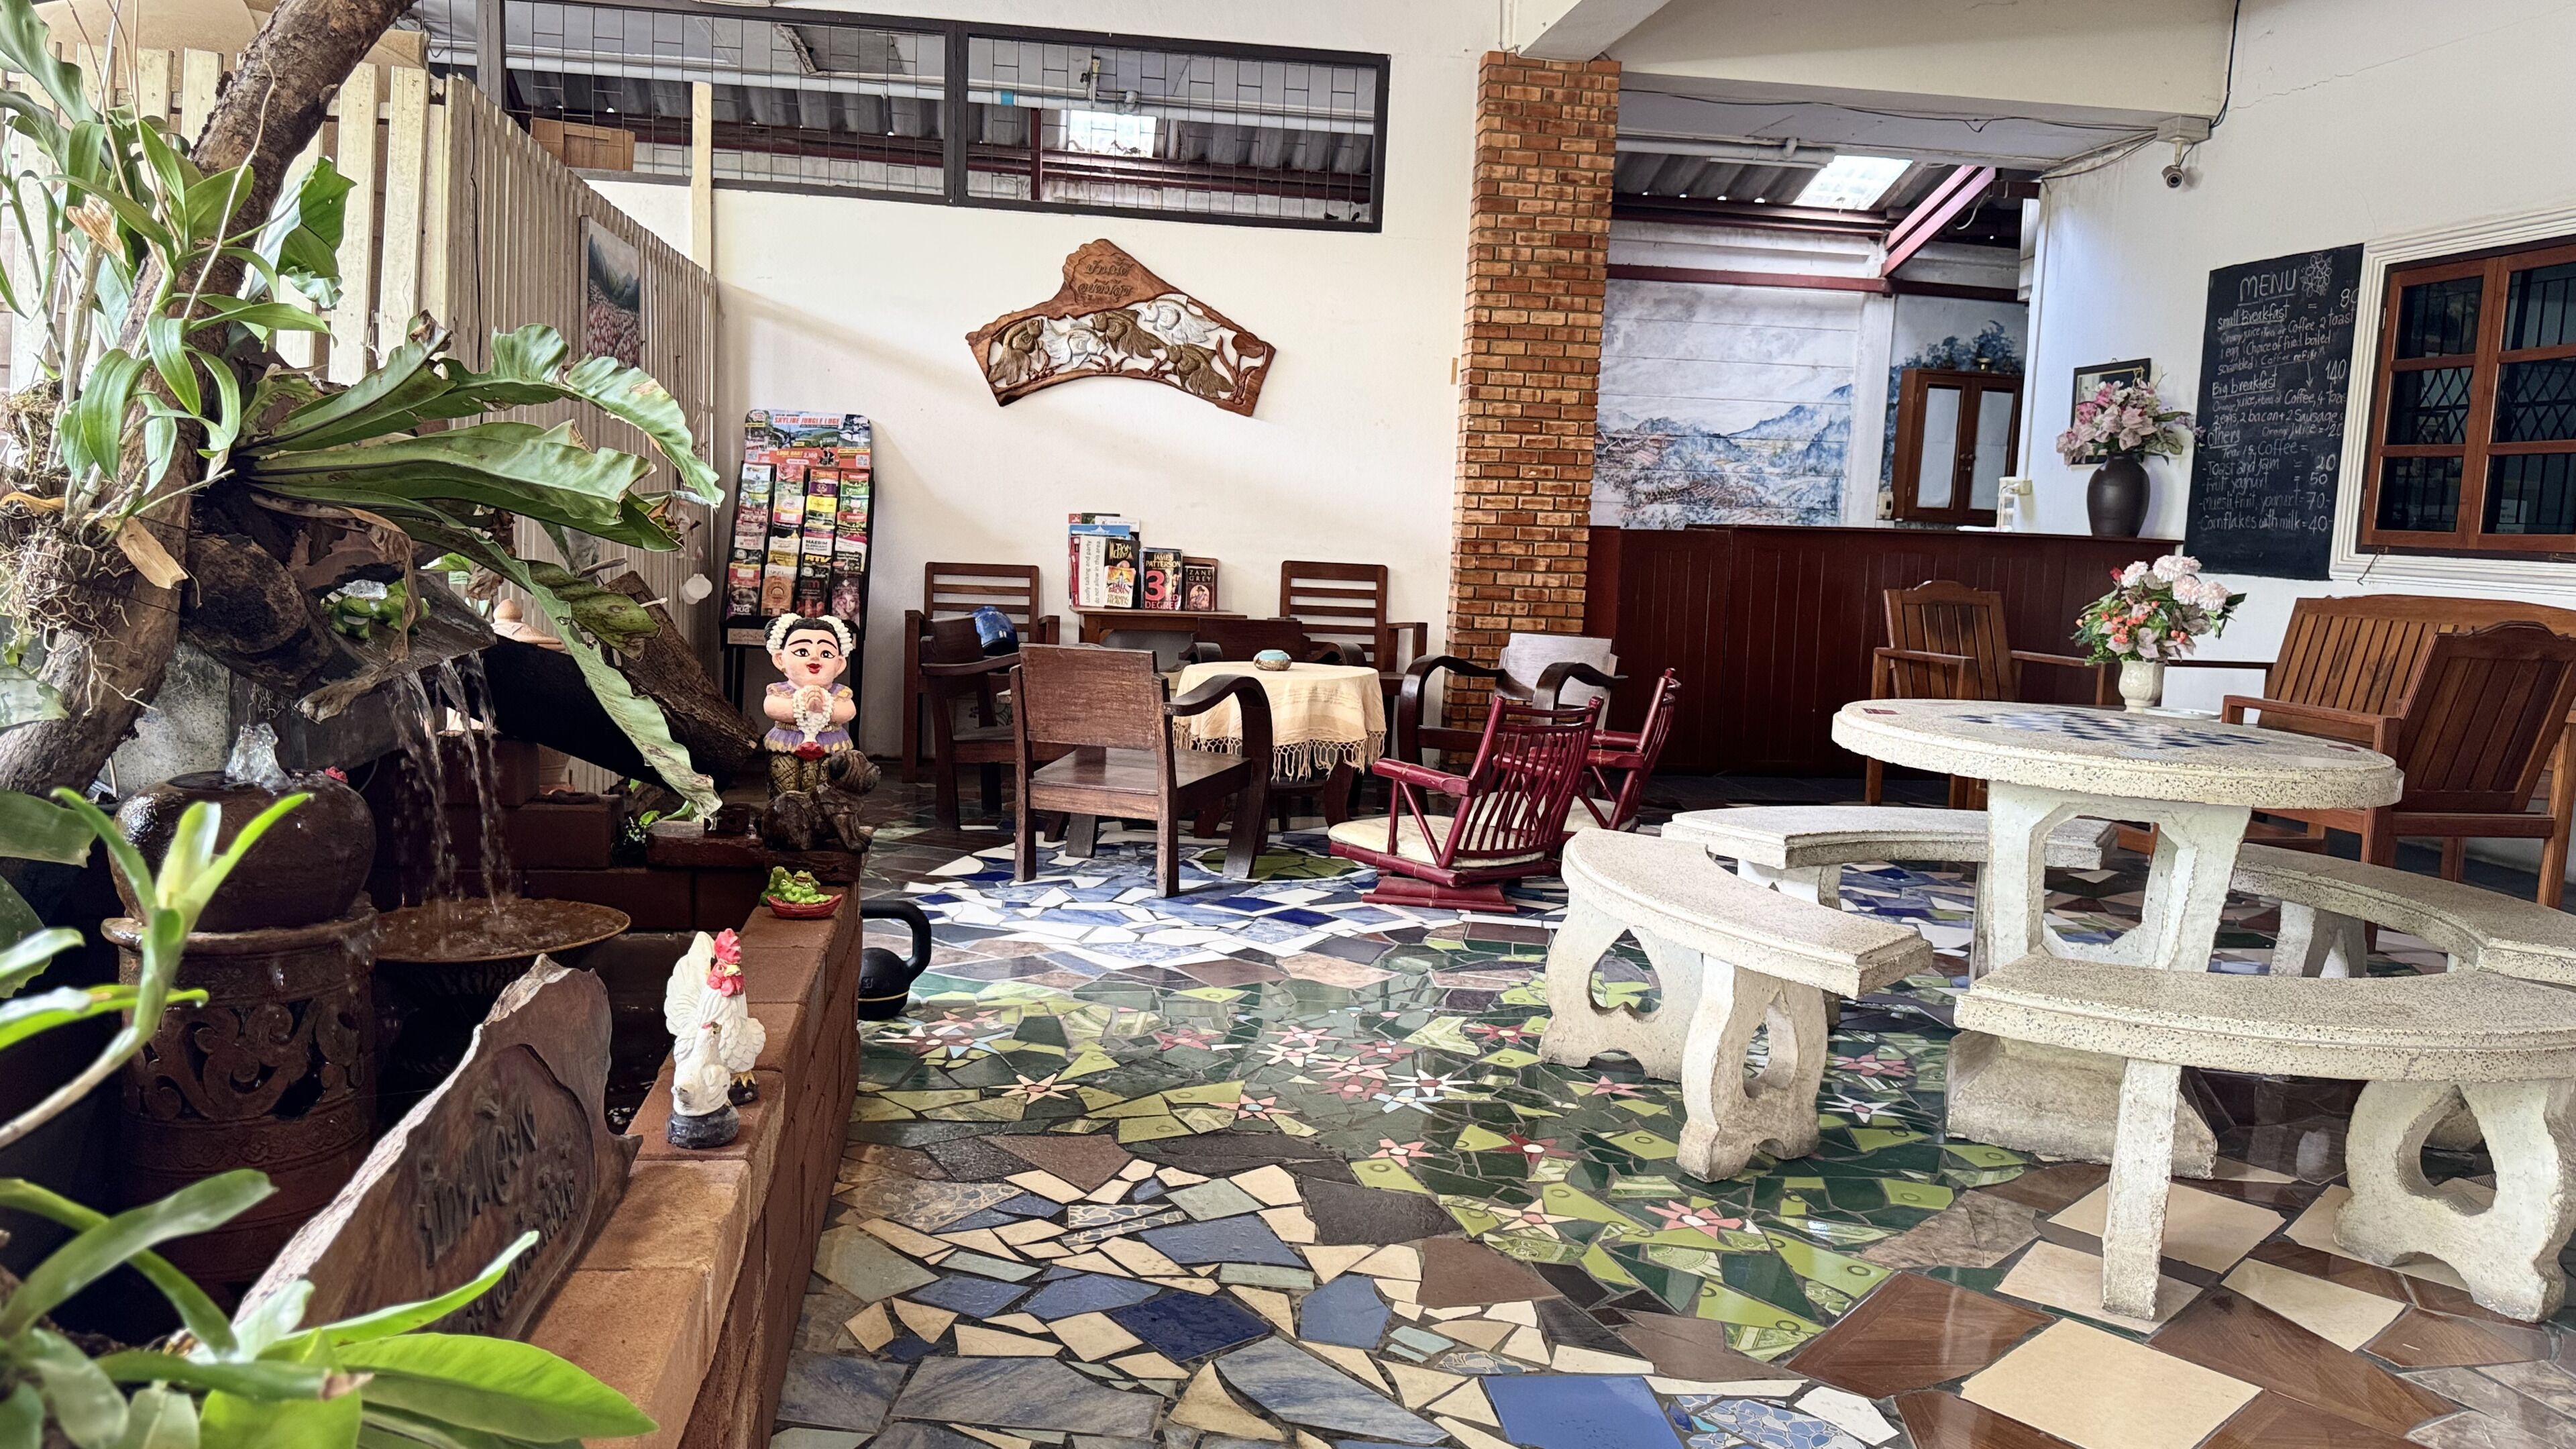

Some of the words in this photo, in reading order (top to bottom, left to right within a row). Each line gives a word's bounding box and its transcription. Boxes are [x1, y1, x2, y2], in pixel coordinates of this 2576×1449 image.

[2239, 268, 2297, 302] MENU
[2319, 317, 2326, 329] 2
[2212, 381, 2228, 400] Big
[2324, 358, 2347, 384] 140
[2257, 438, 2298, 456] Coffee
[2316, 454, 2336, 471] 20
[2310, 472, 2328, 485] 50
[2279, 509, 2301, 531] milk
[804, 554, 832, 563] ATV
[1145, 570, 1166, 601] 3
